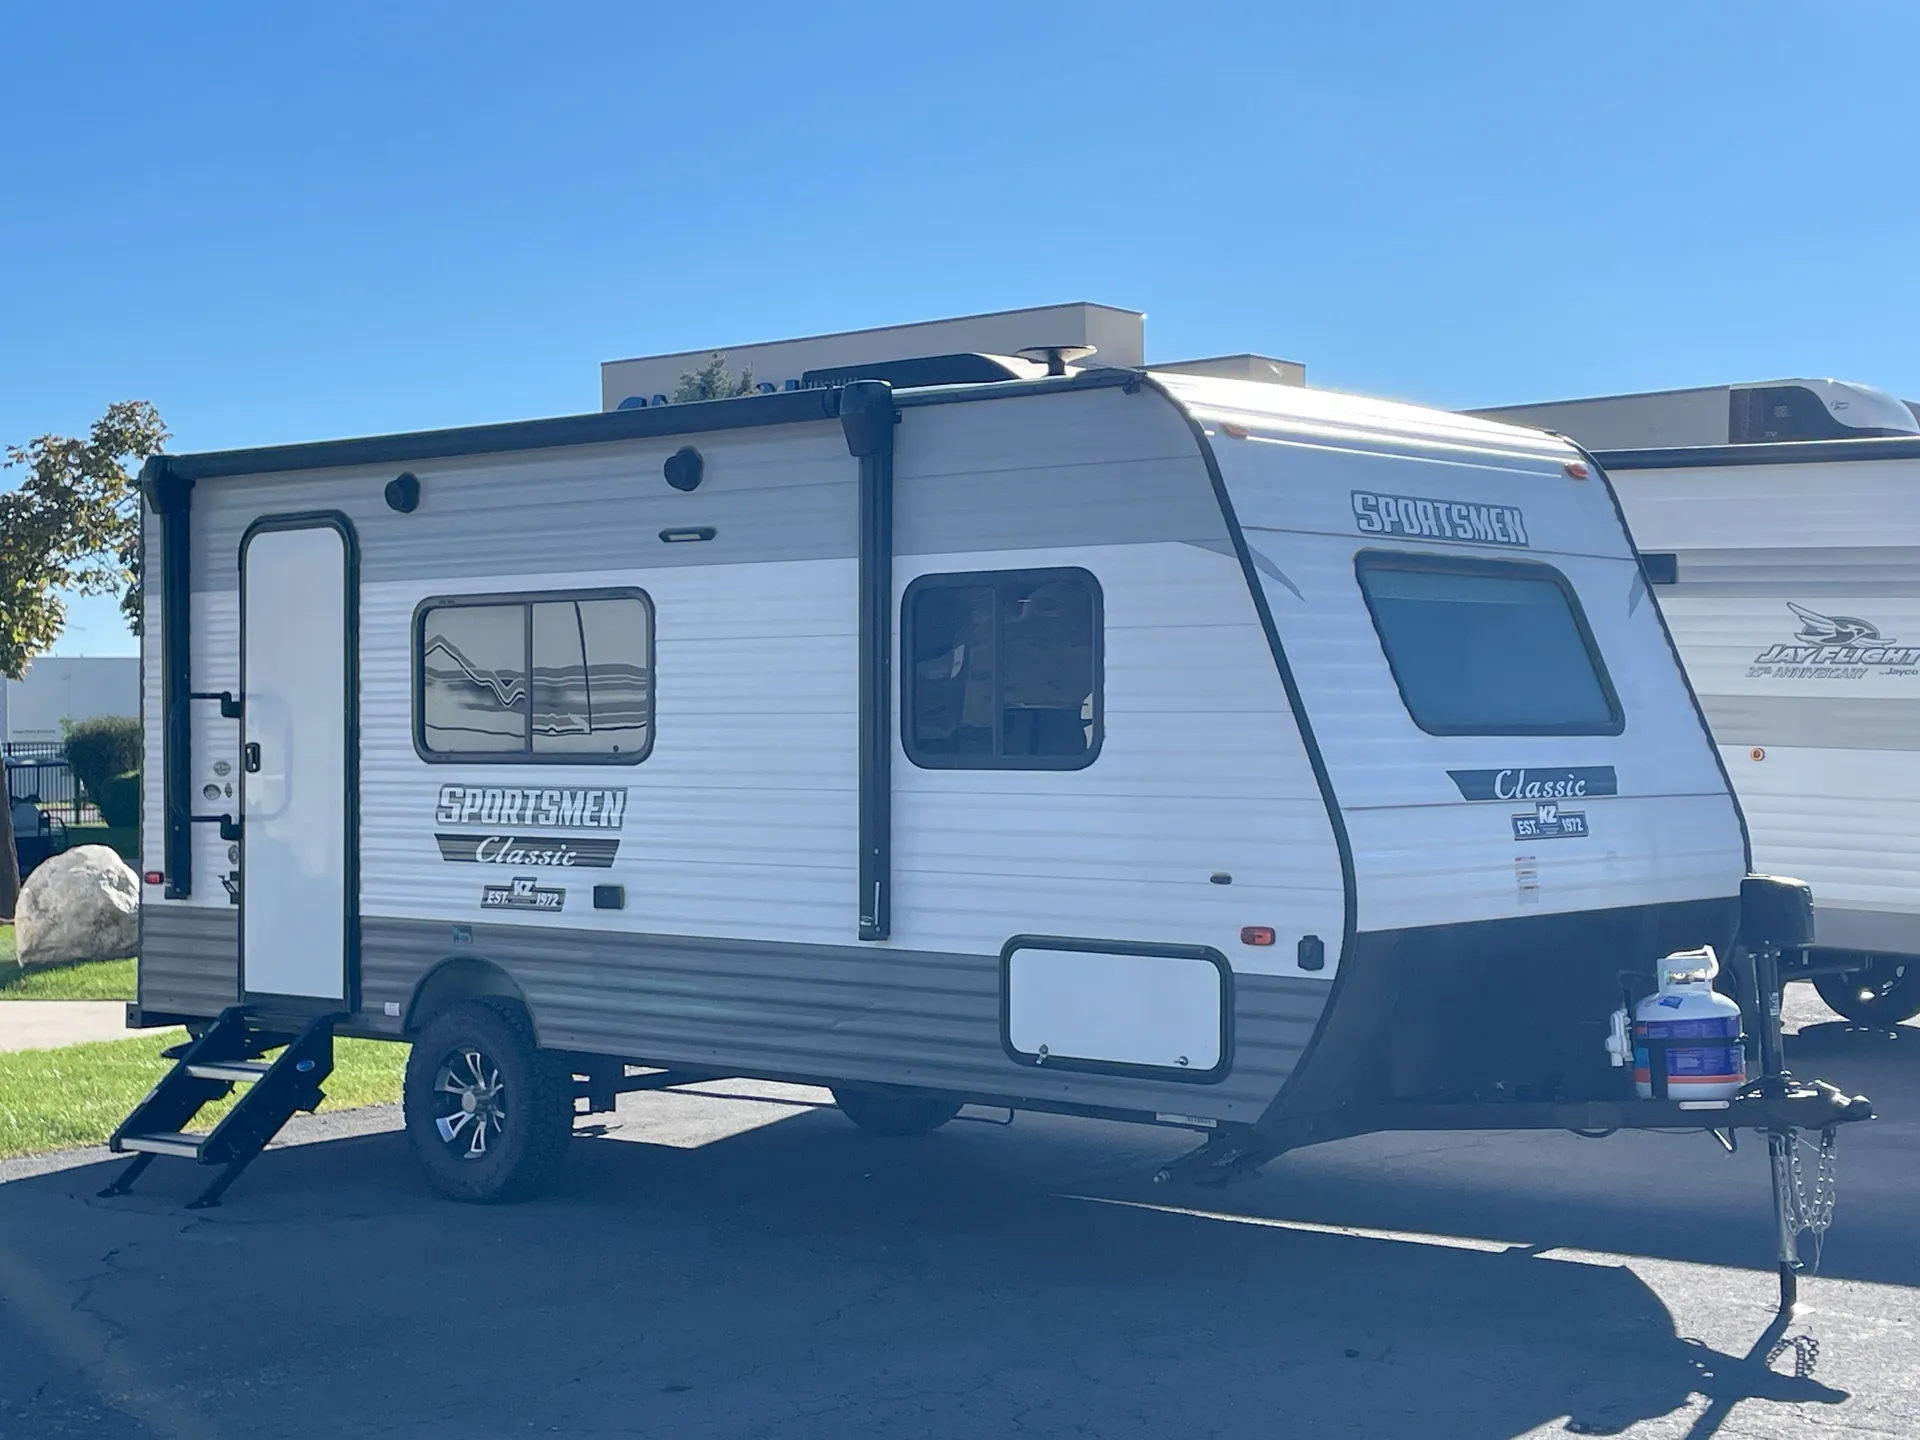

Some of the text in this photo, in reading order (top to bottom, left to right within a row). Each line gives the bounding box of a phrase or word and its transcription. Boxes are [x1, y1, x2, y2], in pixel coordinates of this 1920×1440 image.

[1352, 492, 1528, 544] SPORTSMEN
[1772, 667, 1868, 679] ANNIVERSARY
[1494, 769, 1587, 799] Classic
[437, 786, 625, 828] SPORTSMEN
[1538, 805, 1557, 824] KZ
[1517, 818, 1584, 835] EST. 1972
[474, 836, 577, 867] Classic
[486, 891, 559, 906] EST. 1972
